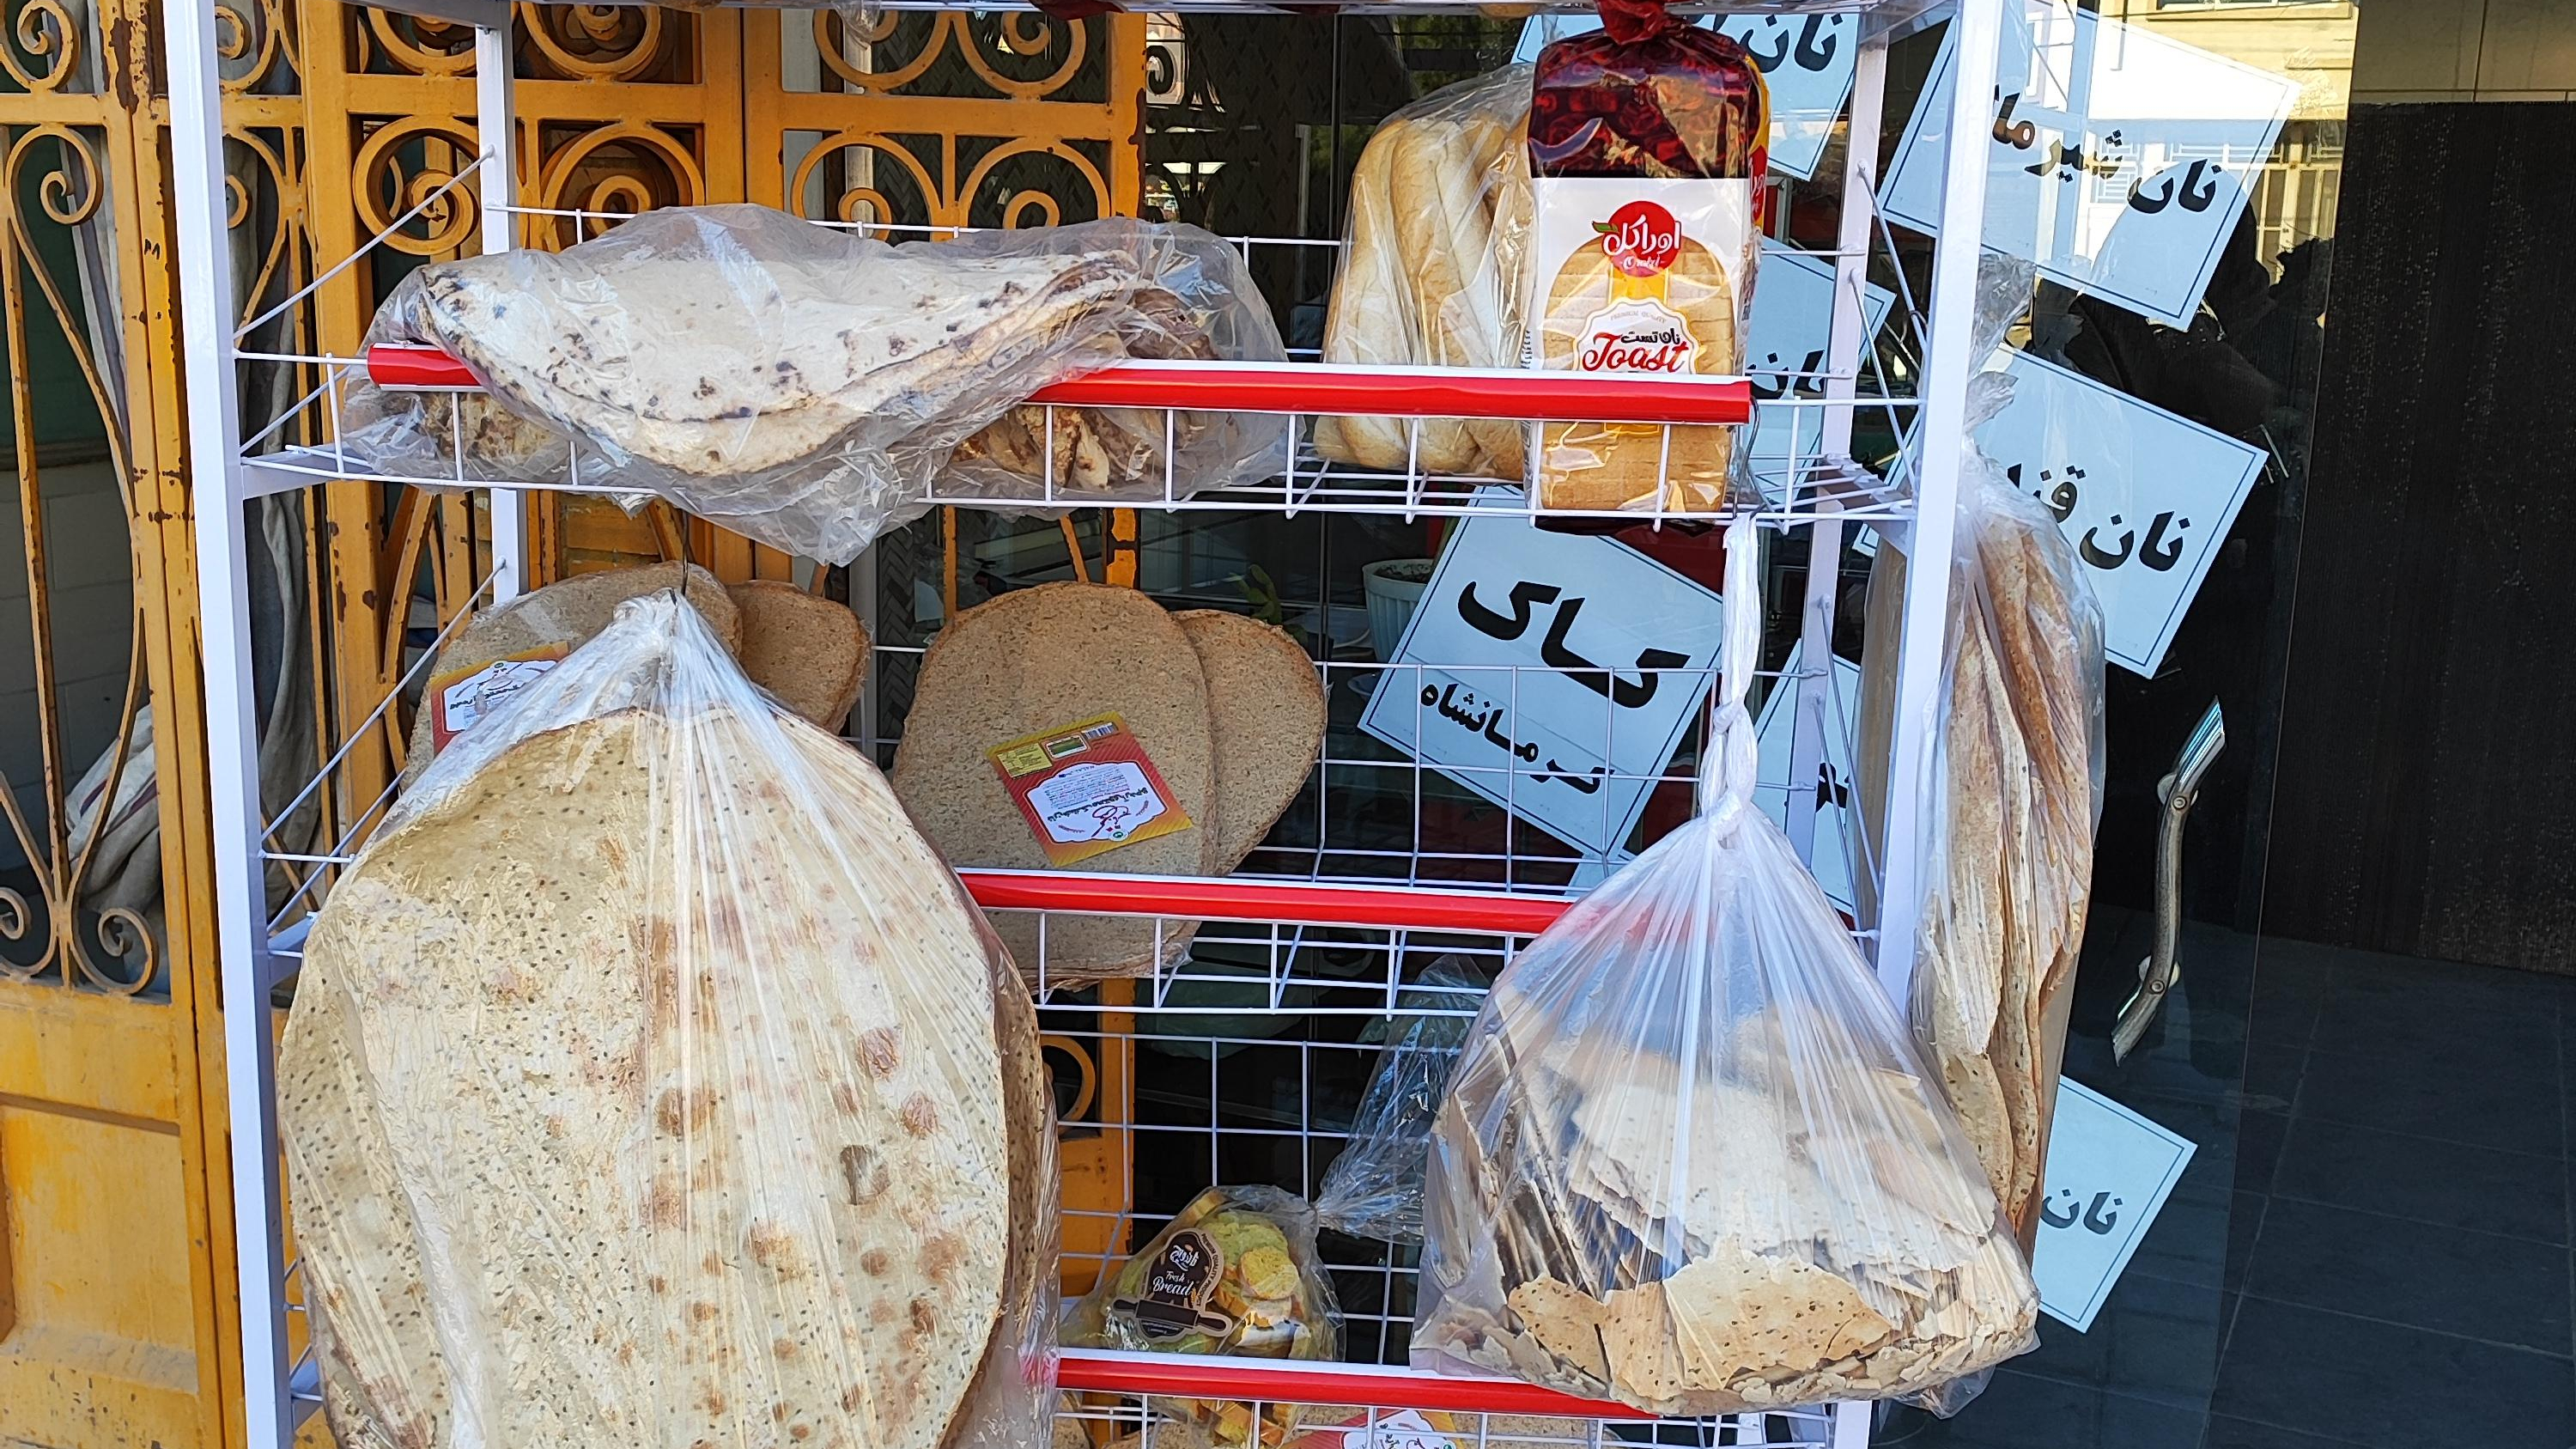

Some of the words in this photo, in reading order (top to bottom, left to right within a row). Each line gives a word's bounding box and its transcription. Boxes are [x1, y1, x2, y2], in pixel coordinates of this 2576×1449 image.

[1739, 14, 1843, 74] نان
[2127, 158, 2222, 214] نان
[1602, 214, 1681, 256] اوراکل
[1583, 332, 1689, 374] Toast
[1620, 331, 1658, 344] تست
[1660, 328, 1680, 344] نان
[2080, 511, 2190, 571] نان
[1457, 581, 1692, 709] کاک
[1420, 684, 1615, 795] کرمانشاه
[2040, 1189, 2123, 1235] نان
[1152, 1275, 1194, 1296] Bread
[1166, 1270, 1185, 1282] Fresh
